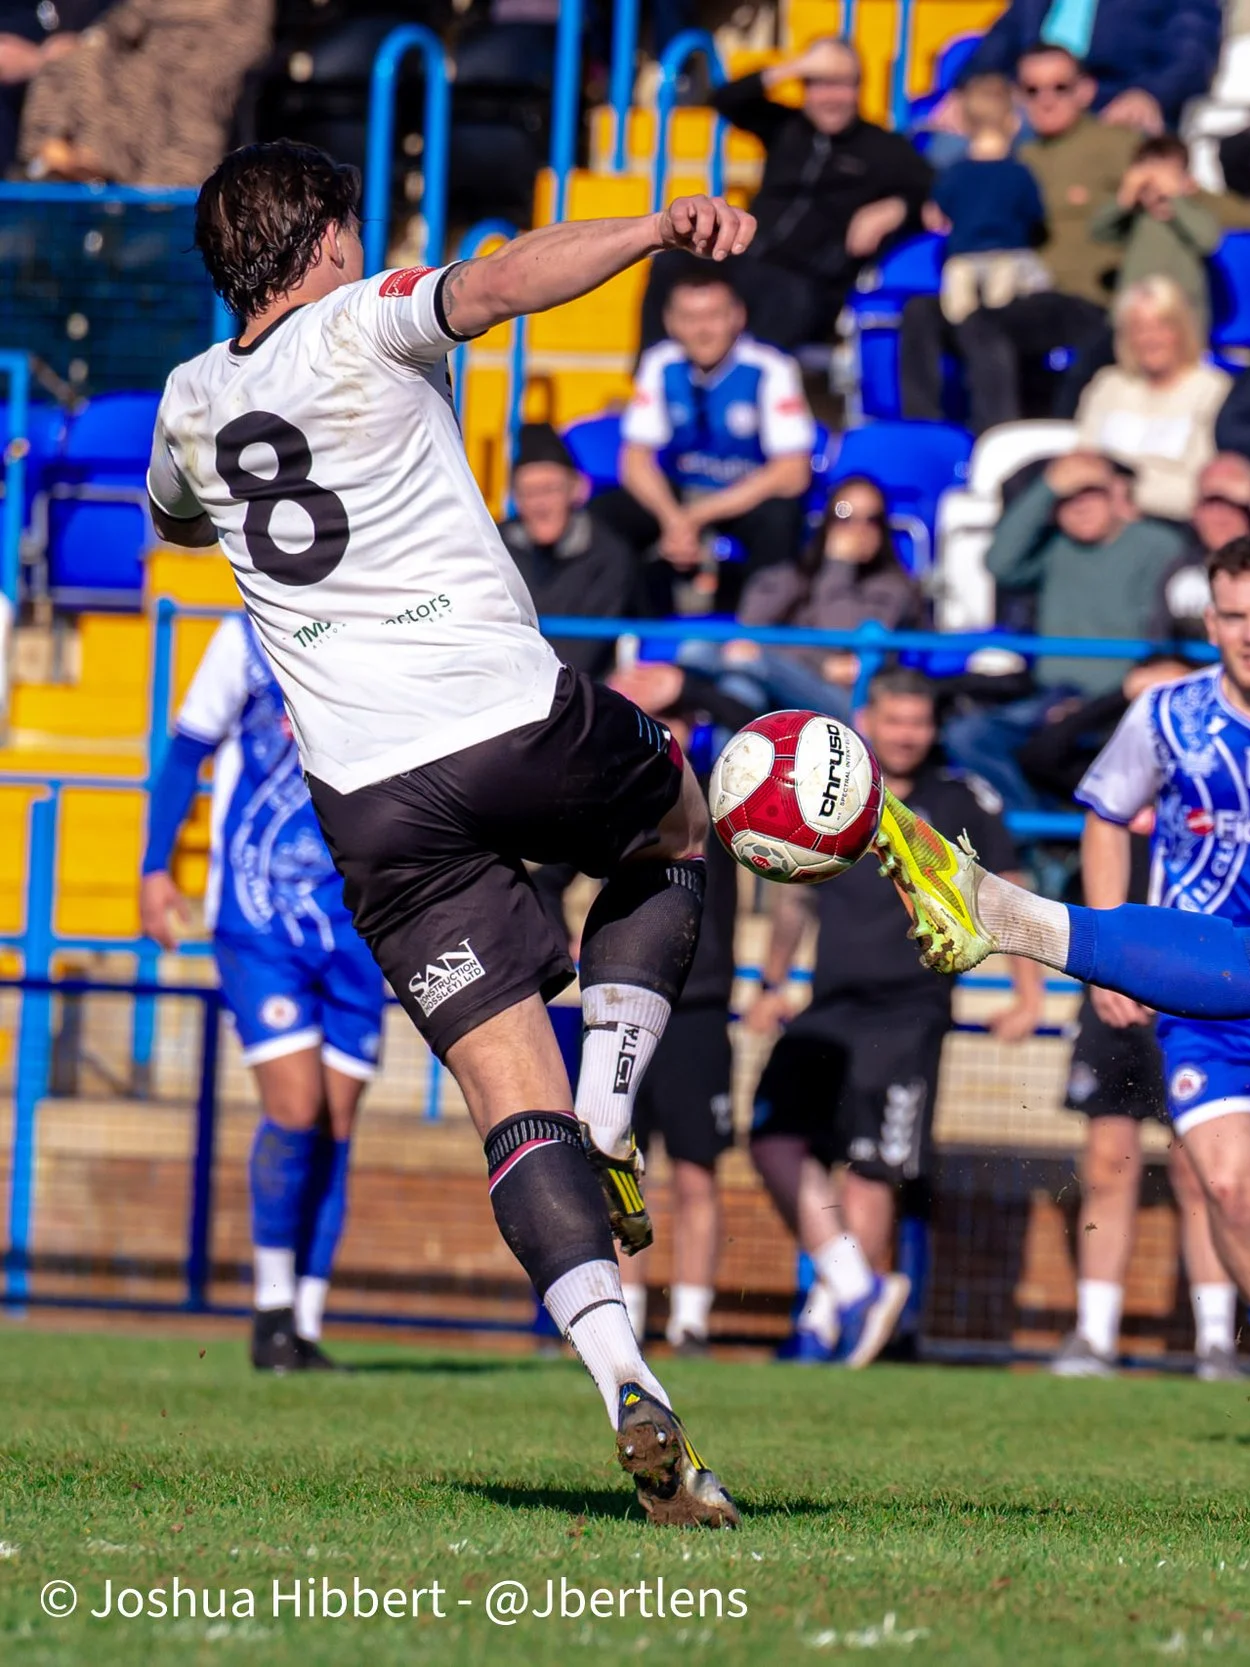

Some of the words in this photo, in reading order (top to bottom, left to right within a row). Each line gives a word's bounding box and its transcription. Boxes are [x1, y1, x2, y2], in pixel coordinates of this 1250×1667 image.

[215, 410, 349, 586] 8
[409, 938, 476, 1000] SAN
[463, 967, 482, 983] LTD
